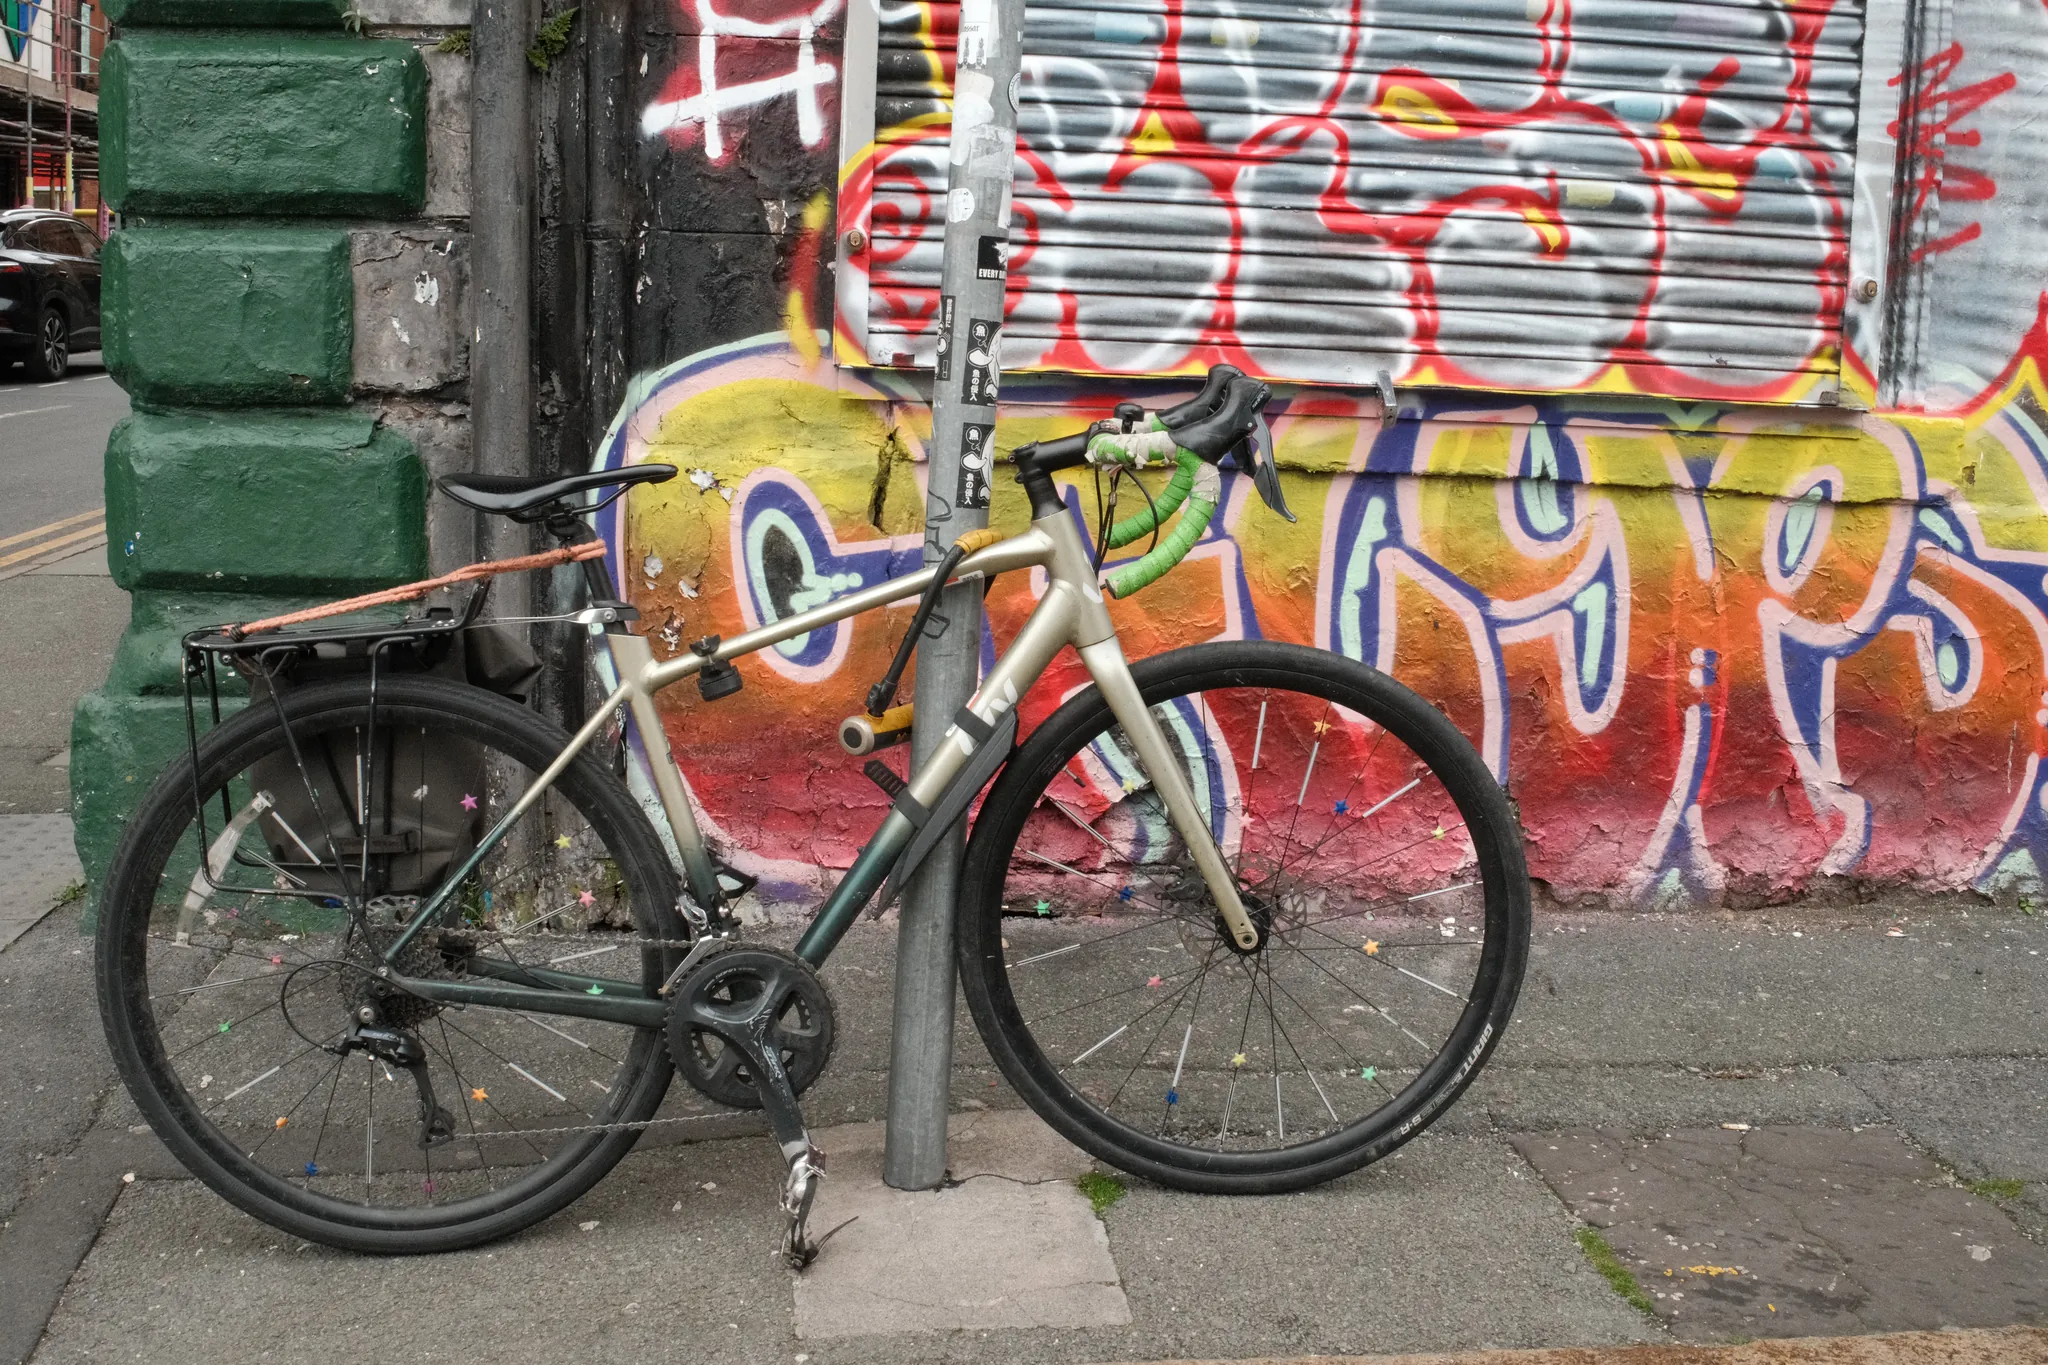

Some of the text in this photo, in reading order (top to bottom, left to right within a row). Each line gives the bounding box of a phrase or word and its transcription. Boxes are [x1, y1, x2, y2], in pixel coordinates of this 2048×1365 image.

[979, 268, 998, 279] EVERY
[975, 325, 986, 337] 魚
[969, 428, 979, 440] 魚
[1460, 1023, 1493, 1077] GIANT
